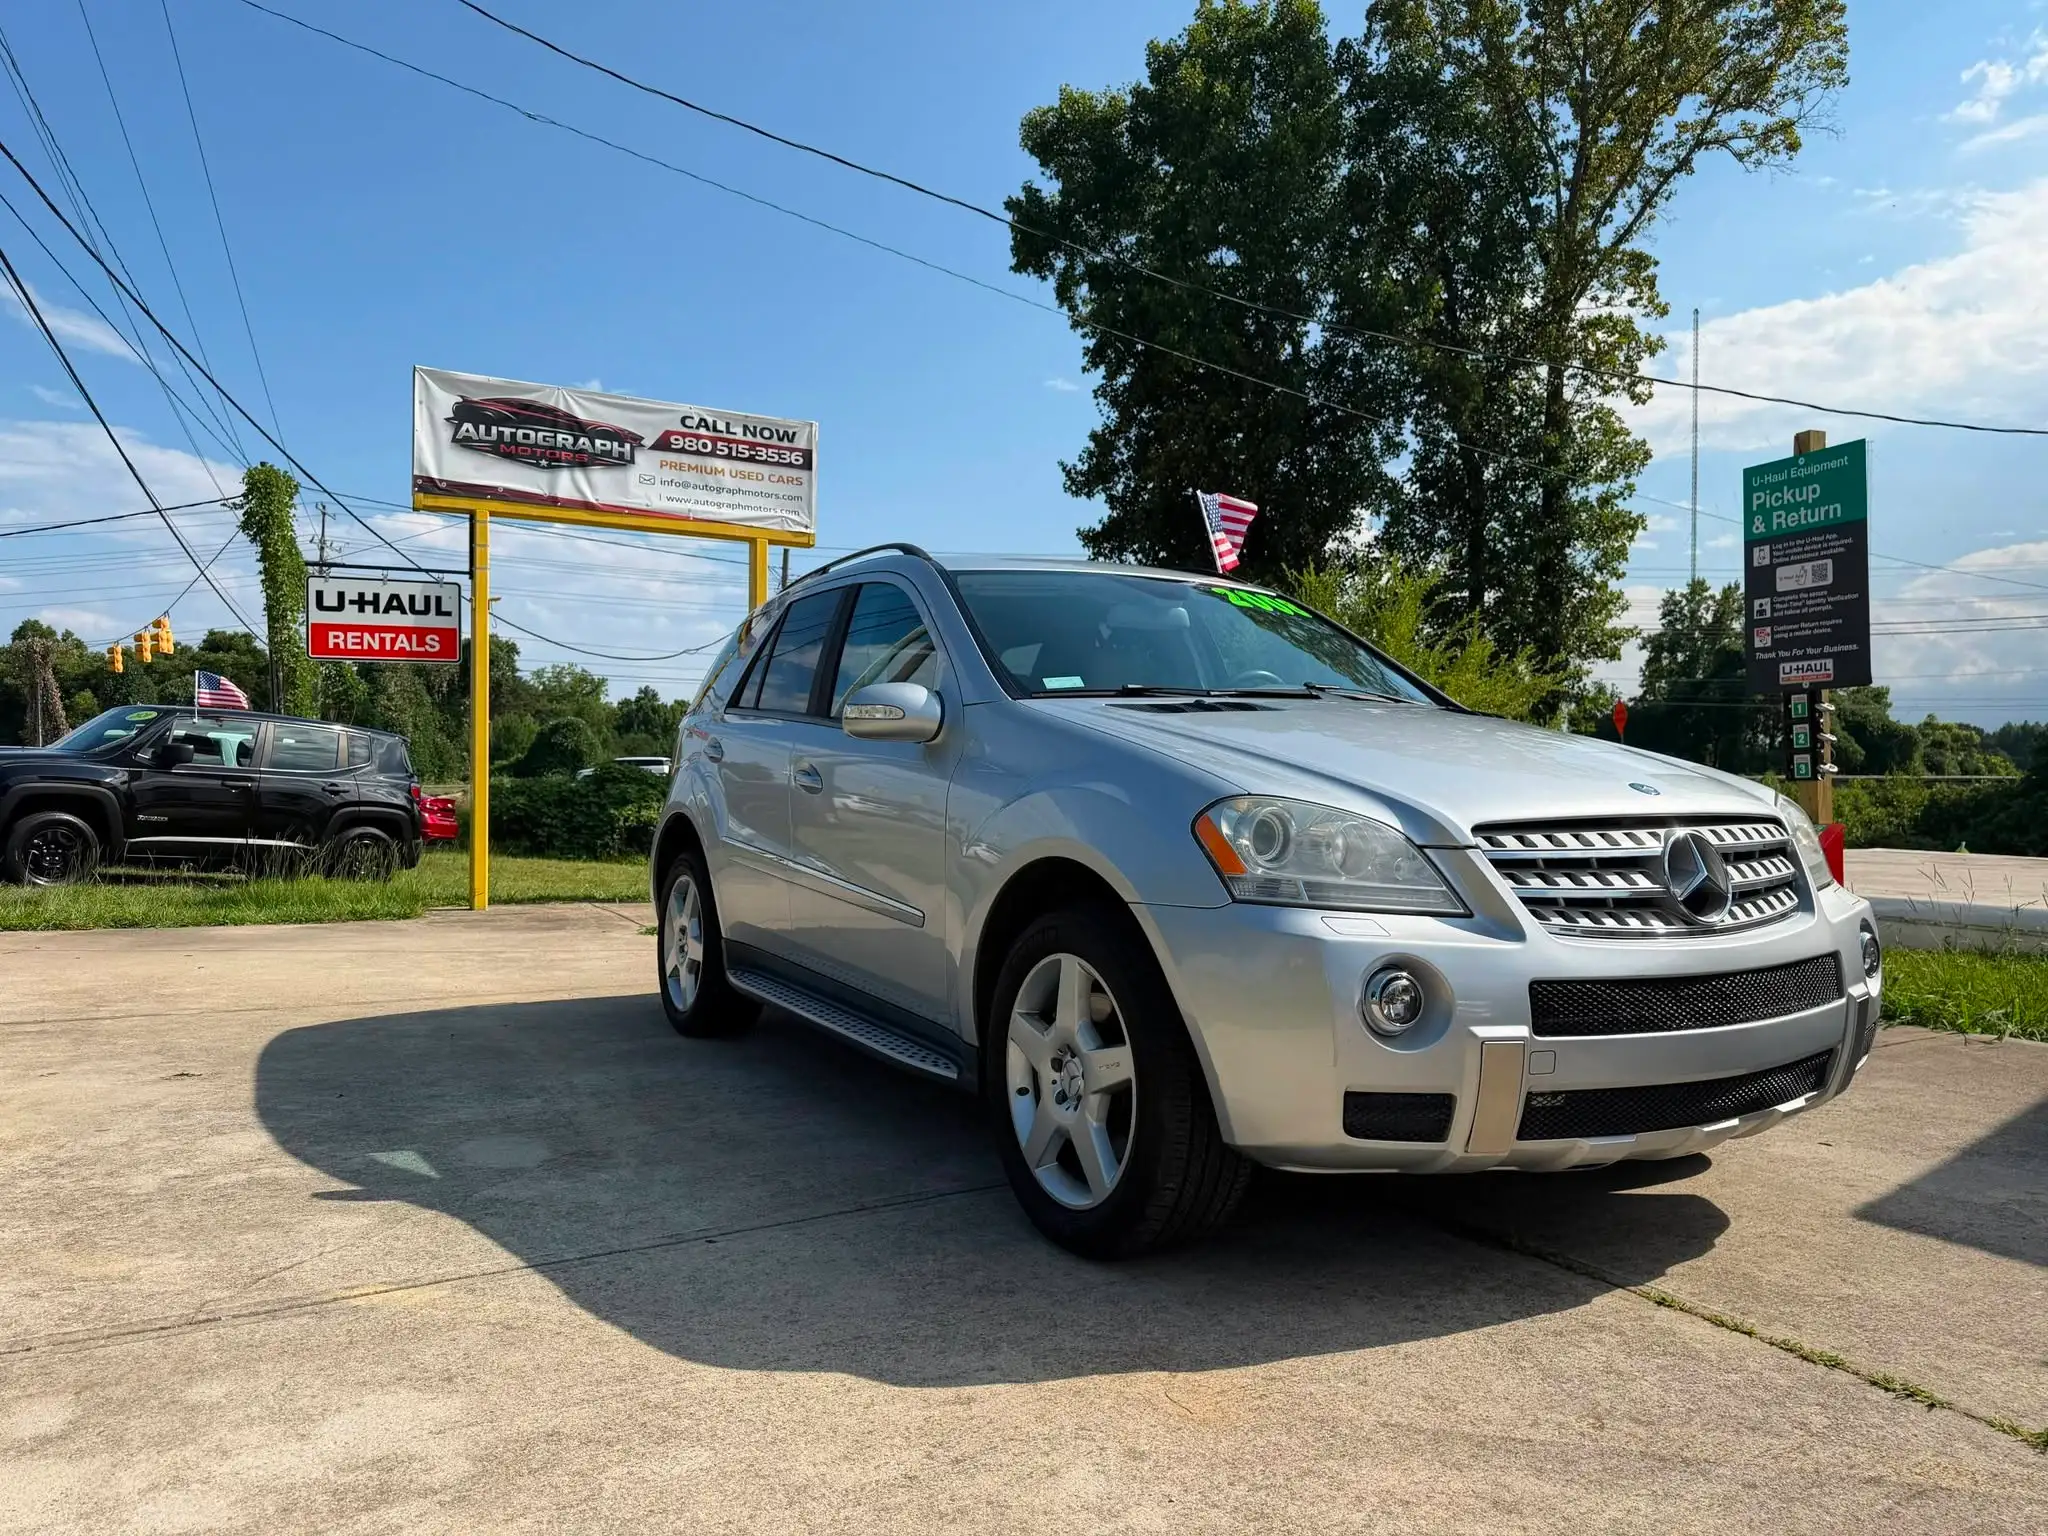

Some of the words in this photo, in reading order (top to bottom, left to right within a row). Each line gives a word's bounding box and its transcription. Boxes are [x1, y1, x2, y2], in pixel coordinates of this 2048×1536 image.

[455, 422, 632, 461] AUTOGRAPH
[680, 415, 737, 435] CALL
[743, 423, 797, 443] NOW
[500, 444, 590, 462] MOTORS
[669, 435, 713, 453] 980
[716, 441, 804, 465] 515-3536
[659, 459, 726, 477] PREMIUM
[729, 469, 765, 482] USED
[768, 473, 803, 486] CARS
[1752, 470, 1788, 487] U-Haul
[1790, 455, 1849, 478] Equipment
[660, 477, 803, 502] info@autographmotors.com
[1752, 483, 1821, 511] Pickup
[666, 495, 800, 517] www.autographmotors.com
[1752, 515, 1766, 534] &
[1772, 502, 1841, 531] Return
[315, 589, 453, 617] U-HAUL
[328, 631, 441, 652] RENTALS
[1755, 652, 1777, 660] Thank
[1777, 650, 1791, 658] You
[1791, 648, 1805, 657] For
[1805, 646, 1823, 655] Your
[1823, 643, 1860, 653] Business.
[1781, 661, 1831, 675] U-HAUL
[1796, 703, 1803, 714] 1
[1797, 733, 1805, 744] 2
[1799, 763, 1806, 774] 3
